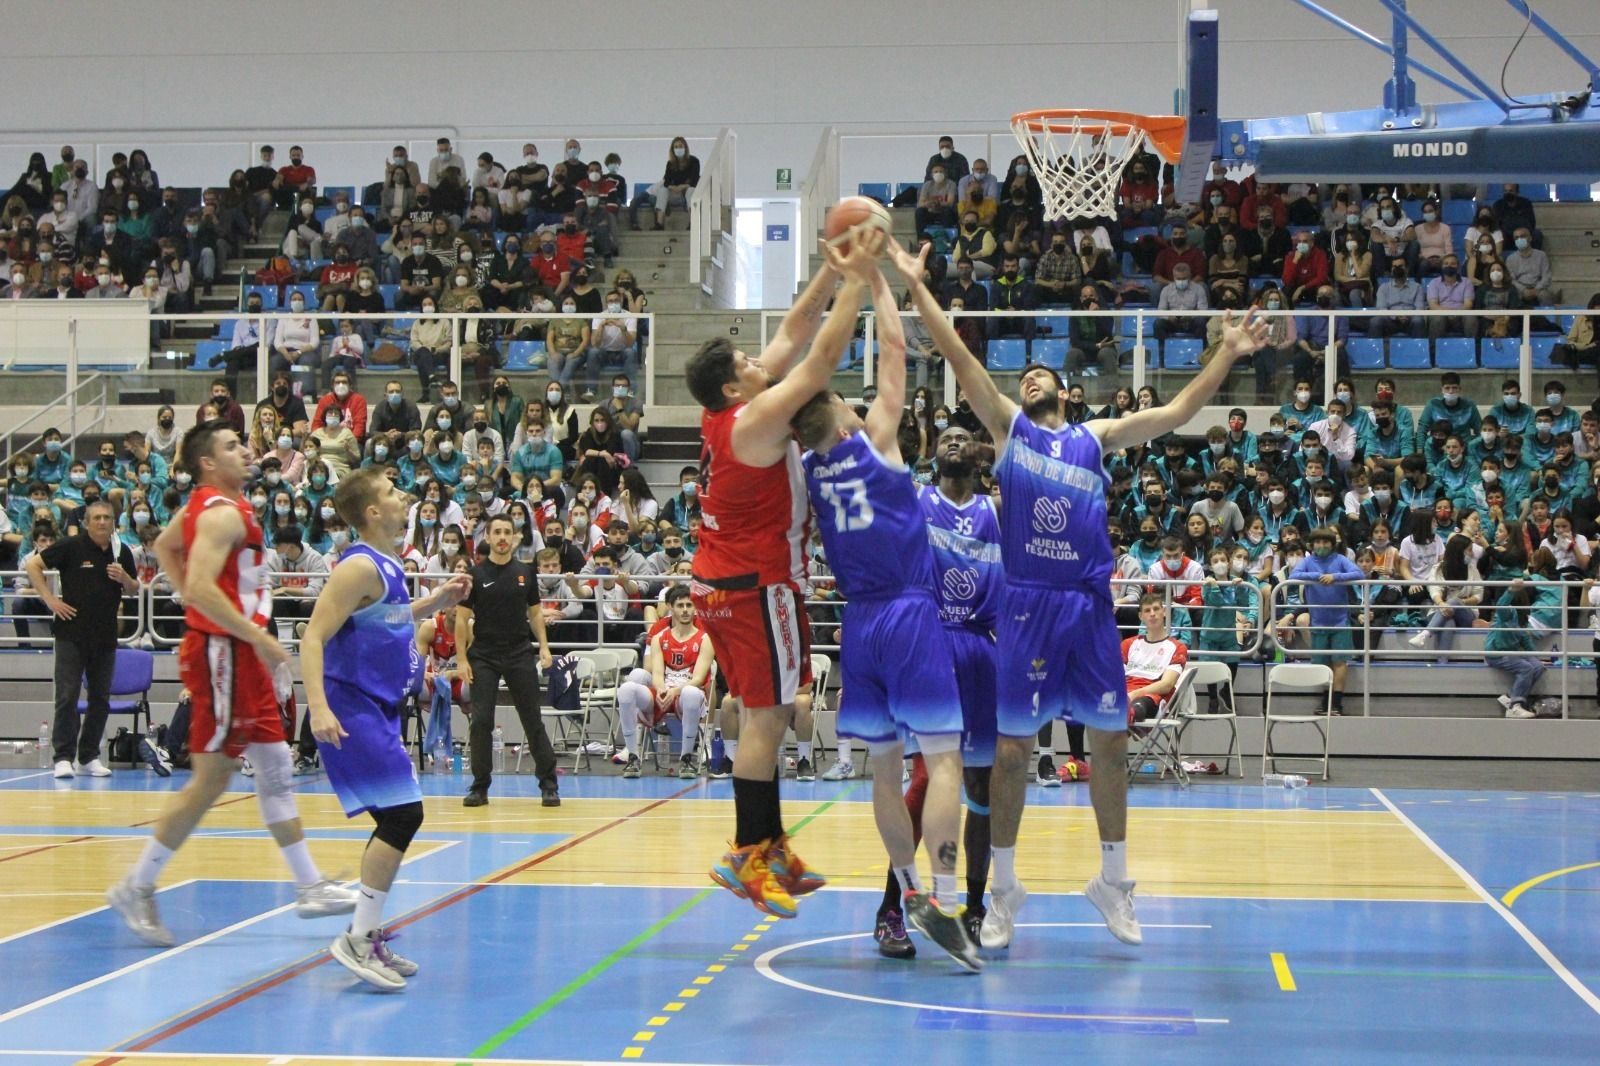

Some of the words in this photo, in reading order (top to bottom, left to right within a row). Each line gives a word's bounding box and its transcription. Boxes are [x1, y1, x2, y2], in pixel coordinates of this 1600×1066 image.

[1393, 142, 1468, 157] MONDO
[1050, 440, 1062, 458] 9
[820, 478, 874, 533] 13
[953, 516, 973, 535] 35
[1032, 537, 1071, 550] HUELVA
[672, 652, 684, 665] 18
